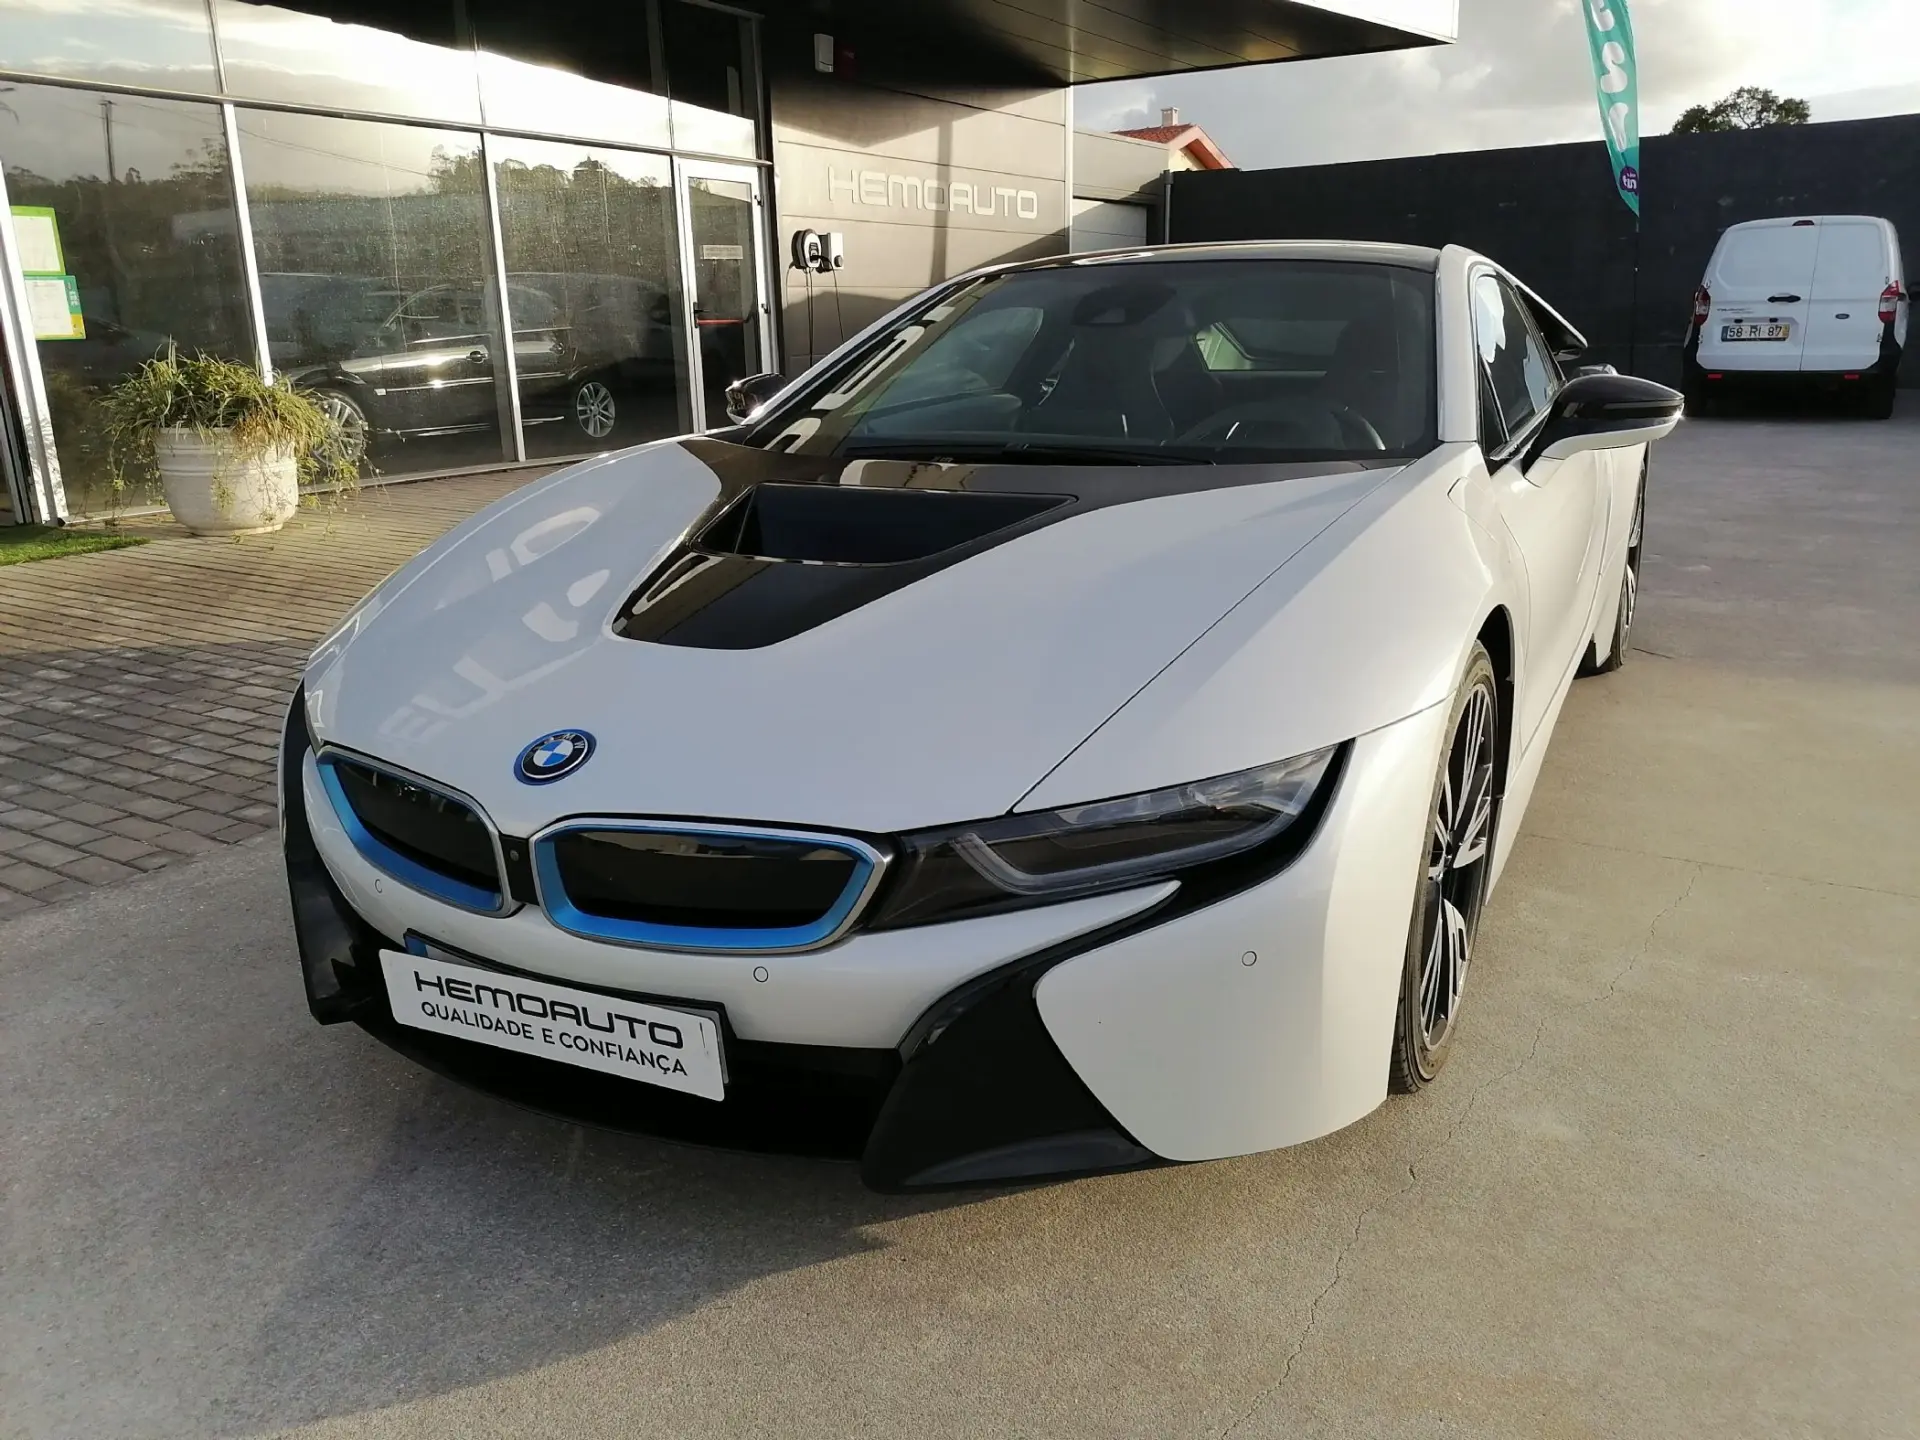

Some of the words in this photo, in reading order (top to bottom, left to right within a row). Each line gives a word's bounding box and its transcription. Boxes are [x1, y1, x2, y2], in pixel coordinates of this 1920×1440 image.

[828, 166, 1038, 220] HEMOAUTO
[1728, 327, 1743, 338] 58
[1767, 326, 1782, 337] 87
[413, 970, 684, 1049] HEMOAUTO
[421, 1001, 534, 1041] QUALIDADE
[542, 1027, 555, 1046] E
[559, 1032, 688, 1076] CONFIANÇA
